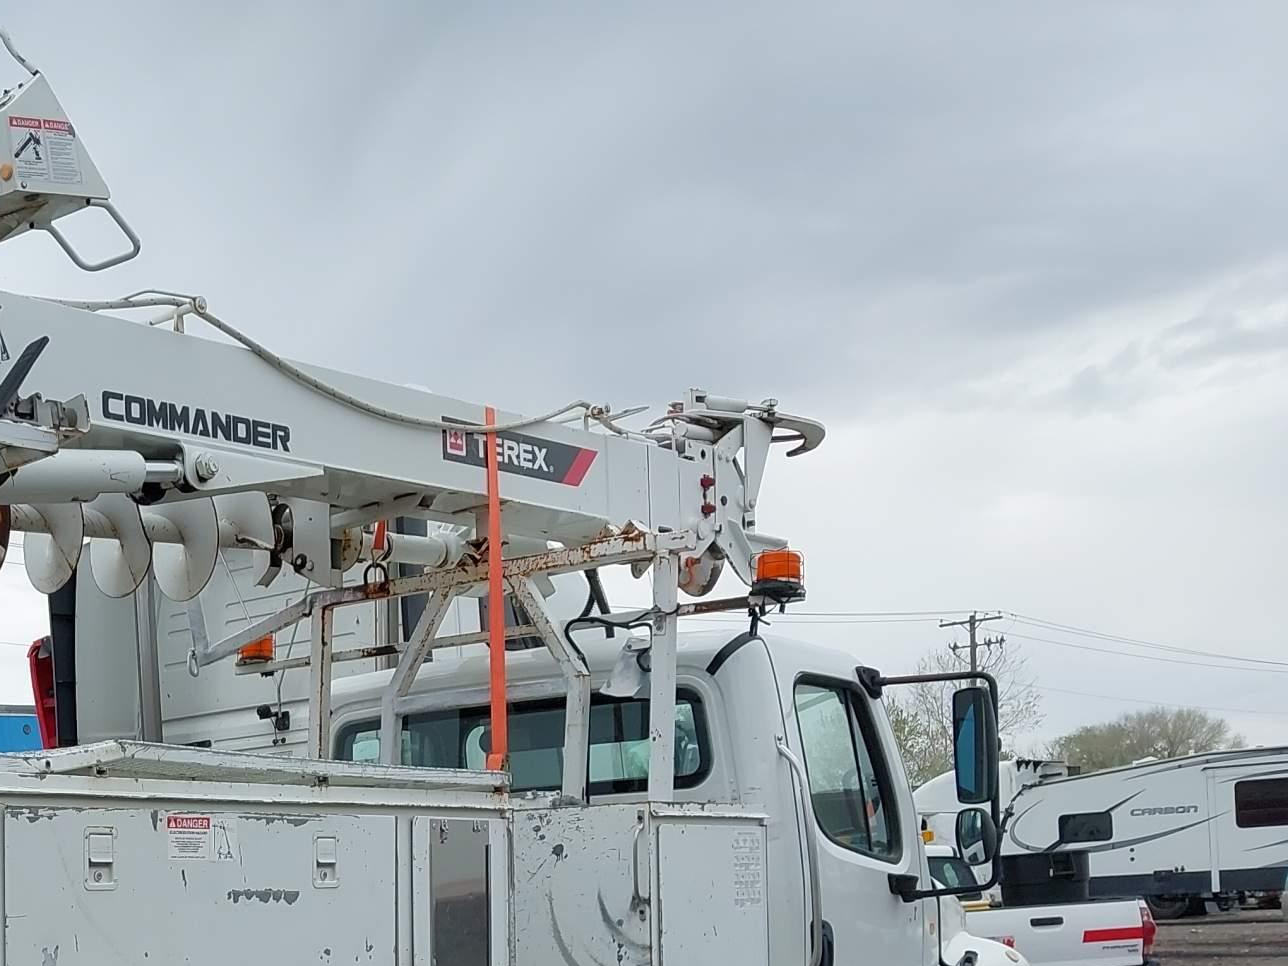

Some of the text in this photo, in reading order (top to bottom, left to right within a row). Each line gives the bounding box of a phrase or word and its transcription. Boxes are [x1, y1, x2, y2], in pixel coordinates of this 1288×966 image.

[102, 390, 291, 453] COMMANDER
[1130, 805, 1198, 817] CARBON
[176, 818, 208, 829] DANGER
